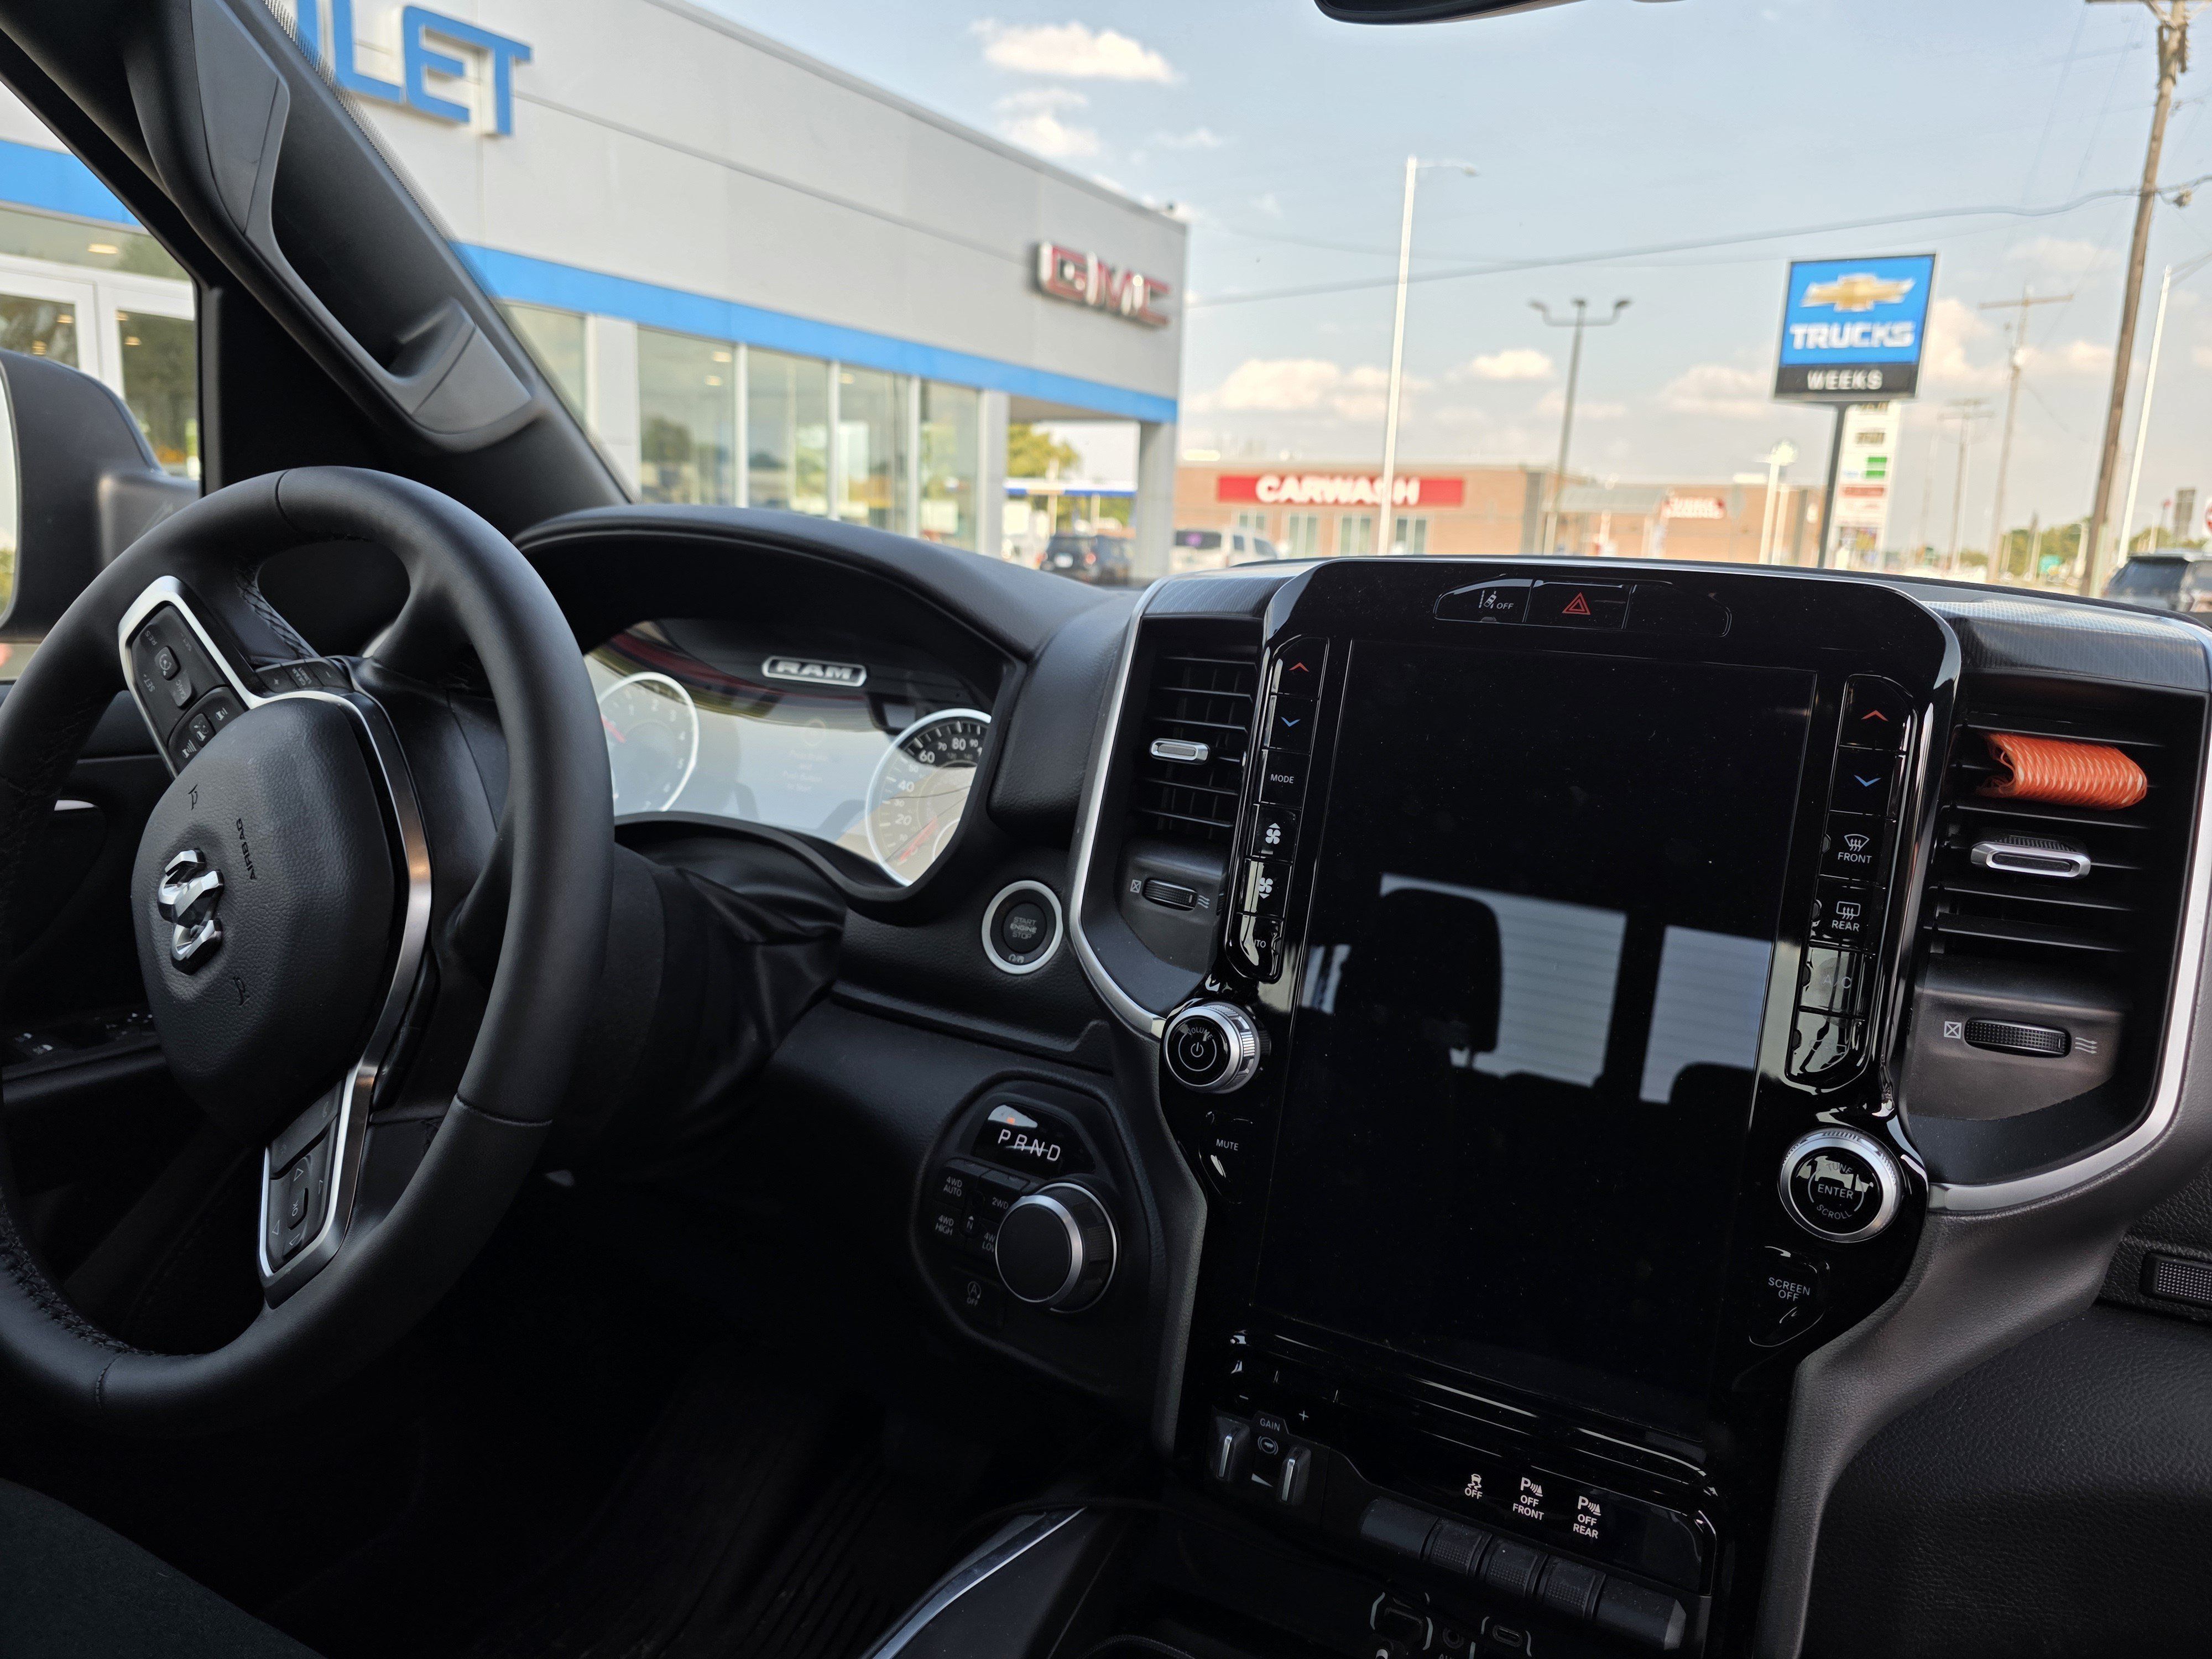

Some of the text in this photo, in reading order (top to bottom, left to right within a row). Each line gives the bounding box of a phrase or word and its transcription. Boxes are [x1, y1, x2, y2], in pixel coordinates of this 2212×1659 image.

[297, 0, 533, 137] LET
[1039, 242, 1170, 326] GMC
[1790, 321, 1916, 349] TRUCKS
[1807, 369, 1883, 390] WEEKS
[1496, 602, 1514, 610] OFF
[775, 661, 854, 680] RAM
[952, 738, 967, 751] 80
[919, 749, 935, 764] 60
[1270, 774, 1295, 784] MODE
[898, 780, 915, 793] 40
[895, 813, 913, 826] 20
[236, 817, 257, 880] AIRBAG
[1837, 852, 1872, 864] FRONT
[1010, 922, 1037, 933] ENGINE
[1013, 916, 1037, 926] START
[1831, 920, 1860, 932] REAR
[1012, 931, 1032, 940] STOP
[1188, 1027, 1213, 1040] VOLUME
[1215, 1138, 1239, 1151] MUTE
[1827, 1163, 1853, 1175] TUNE
[946, 1176, 963, 1188] 4WD
[943, 1184, 962, 1197] AUTO
[1818, 1183, 1854, 1200] ENTER
[992, 1197, 1009, 1210] 2WD
[1816, 1204, 1853, 1220] SCROLL
[938, 1214, 954, 1226] 4WD
[935, 1222, 953, 1236] HIGH
[1768, 1277, 1811, 1296] SCREEN
[1778, 1289, 1799, 1302] OFF
[1260, 1417, 1281, 1432] GAIN
[1464, 1488, 1483, 1499] OFF
[1520, 1495, 1540, 1507] OFF
[1512, 1503, 1545, 1520] FRONT
[1577, 1514, 1597, 1526] OFF
[1573, 1524, 1599, 1538] REAR
